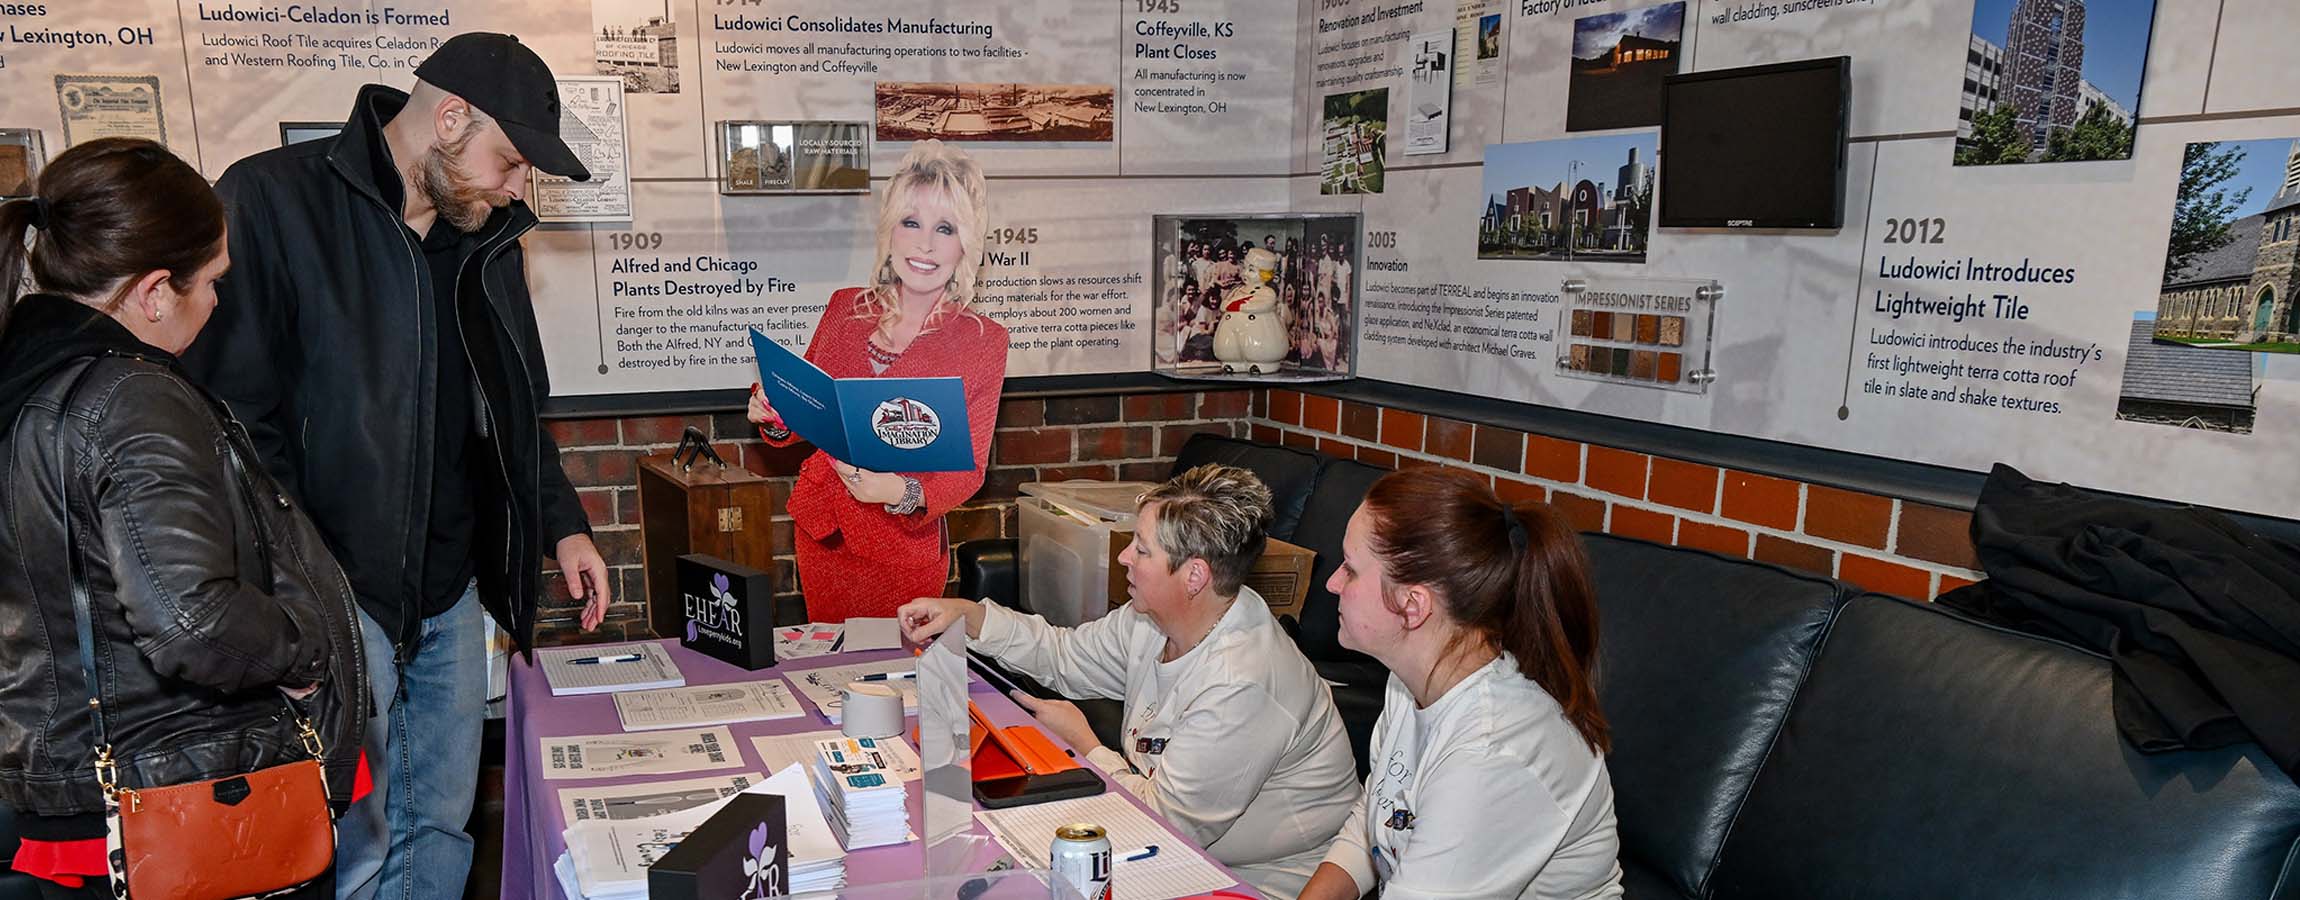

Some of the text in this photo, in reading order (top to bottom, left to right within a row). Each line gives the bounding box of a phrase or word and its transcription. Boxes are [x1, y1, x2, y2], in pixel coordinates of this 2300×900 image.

[199, 3, 451, 26] Ludowici-Celadon is Formed
[1135, 0, 1180, 13] 1945
[1521, 0, 1561, 17] Factory
[1319, 1, 1423, 34] Renovation and Investment
[1712, 8, 1731, 25] wall
[714, 14, 993, 39] Ludowici Consolidates Manufacturing
[1135, 20, 1234, 40] Coffeyville, KS
[11, 25, 113, 48] Lexington,
[117, 26, 153, 45] OH
[202, 32, 259, 48] Ludowici
[262, 34, 293, 48] Roof
[295, 34, 319, 49] Tile
[322, 36, 372, 53] acquires
[376, 35, 427, 50] Celadon
[715, 41, 1022, 59] Ludowici moves all manufacturing operations two facilities
[1135, 43, 1217, 60] Plant Closes
[205, 55, 228, 67] and
[231, 53, 284, 67] Western
[287, 53, 337, 70] Roofing
[368, 55, 391, 68] Co.
[394, 56, 405, 68] in
[716, 60, 878, 76] New Lexington and Coffeyville
[1134, 68, 1247, 83] All manufacturing now
[1134, 86, 1195, 97] concentrated
[1134, 101, 1156, 113] New
[1208, 101, 1227, 113] OH
[800, 139, 829, 147] LOCALLY
[804, 148, 859, 156] RAW MATERIALS
[1883, 217, 1946, 244] 2012
[609, 232, 662, 250] 1909
[1367, 231, 1397, 249] 2003
[611, 256, 758, 276] Alfred and Chicago
[988, 252, 1017, 267] War
[1366, 256, 1408, 273] Innovation
[1879, 255, 2076, 284] Ludowici Introduces
[613, 277, 796, 298] Plants Destroyed by Fire
[985, 272, 1143, 289] production slows resources shift
[1006, 292, 1048, 304] materials
[1050, 291, 1064, 302] for
[1066, 290, 1081, 302] the
[1083, 291, 1100, 301] war
[1437, 283, 1560, 304] TERREAL and begins innovation
[1574, 291, 1693, 313] IMPRESSIONIST SERIES
[614, 306, 636, 318] Fire
[638, 305, 664, 317] from
[666, 304, 684, 317] the
[686, 304, 703, 316] old
[705, 304, 728, 316] kilns
[766, 306, 789, 314] ever
[988, 308, 1028, 320] employs
[1029, 307, 1057, 318] about
[1059, 307, 1078, 317] 200
[1079, 307, 1113, 317] women
[1114, 304, 1132, 315] and
[1484, 305, 1539, 322] Series patented
[1874, 289, 2030, 323] Lightweight Tile
[616, 319, 809, 340] danger to the facilities.
[1040, 319, 1136, 334] terra cotta pieces like
[1462, 322, 1538, 341] economical terra cotta
[617, 340, 642, 352] Both
[645, 339, 663, 351] the
[704, 337, 723, 348] NY
[725, 336, 745, 348] and
[1008, 336, 1122, 351] keep the plant operating.
[1481, 341, 1510, 357] Michael
[1870, 327, 1926, 348] Ludowici
[1928, 332, 1999, 354] introduces
[2002, 336, 2026, 356] the
[618, 355, 738, 370] destroyed by fire the
[1867, 352, 2078, 388] first lightweight terra cotta roof
[1863, 378, 2063, 415] tile in slate and shake textures.
[877, 428, 938, 439] IMAGINATION
[889, 437, 928, 447] LIBRARY
